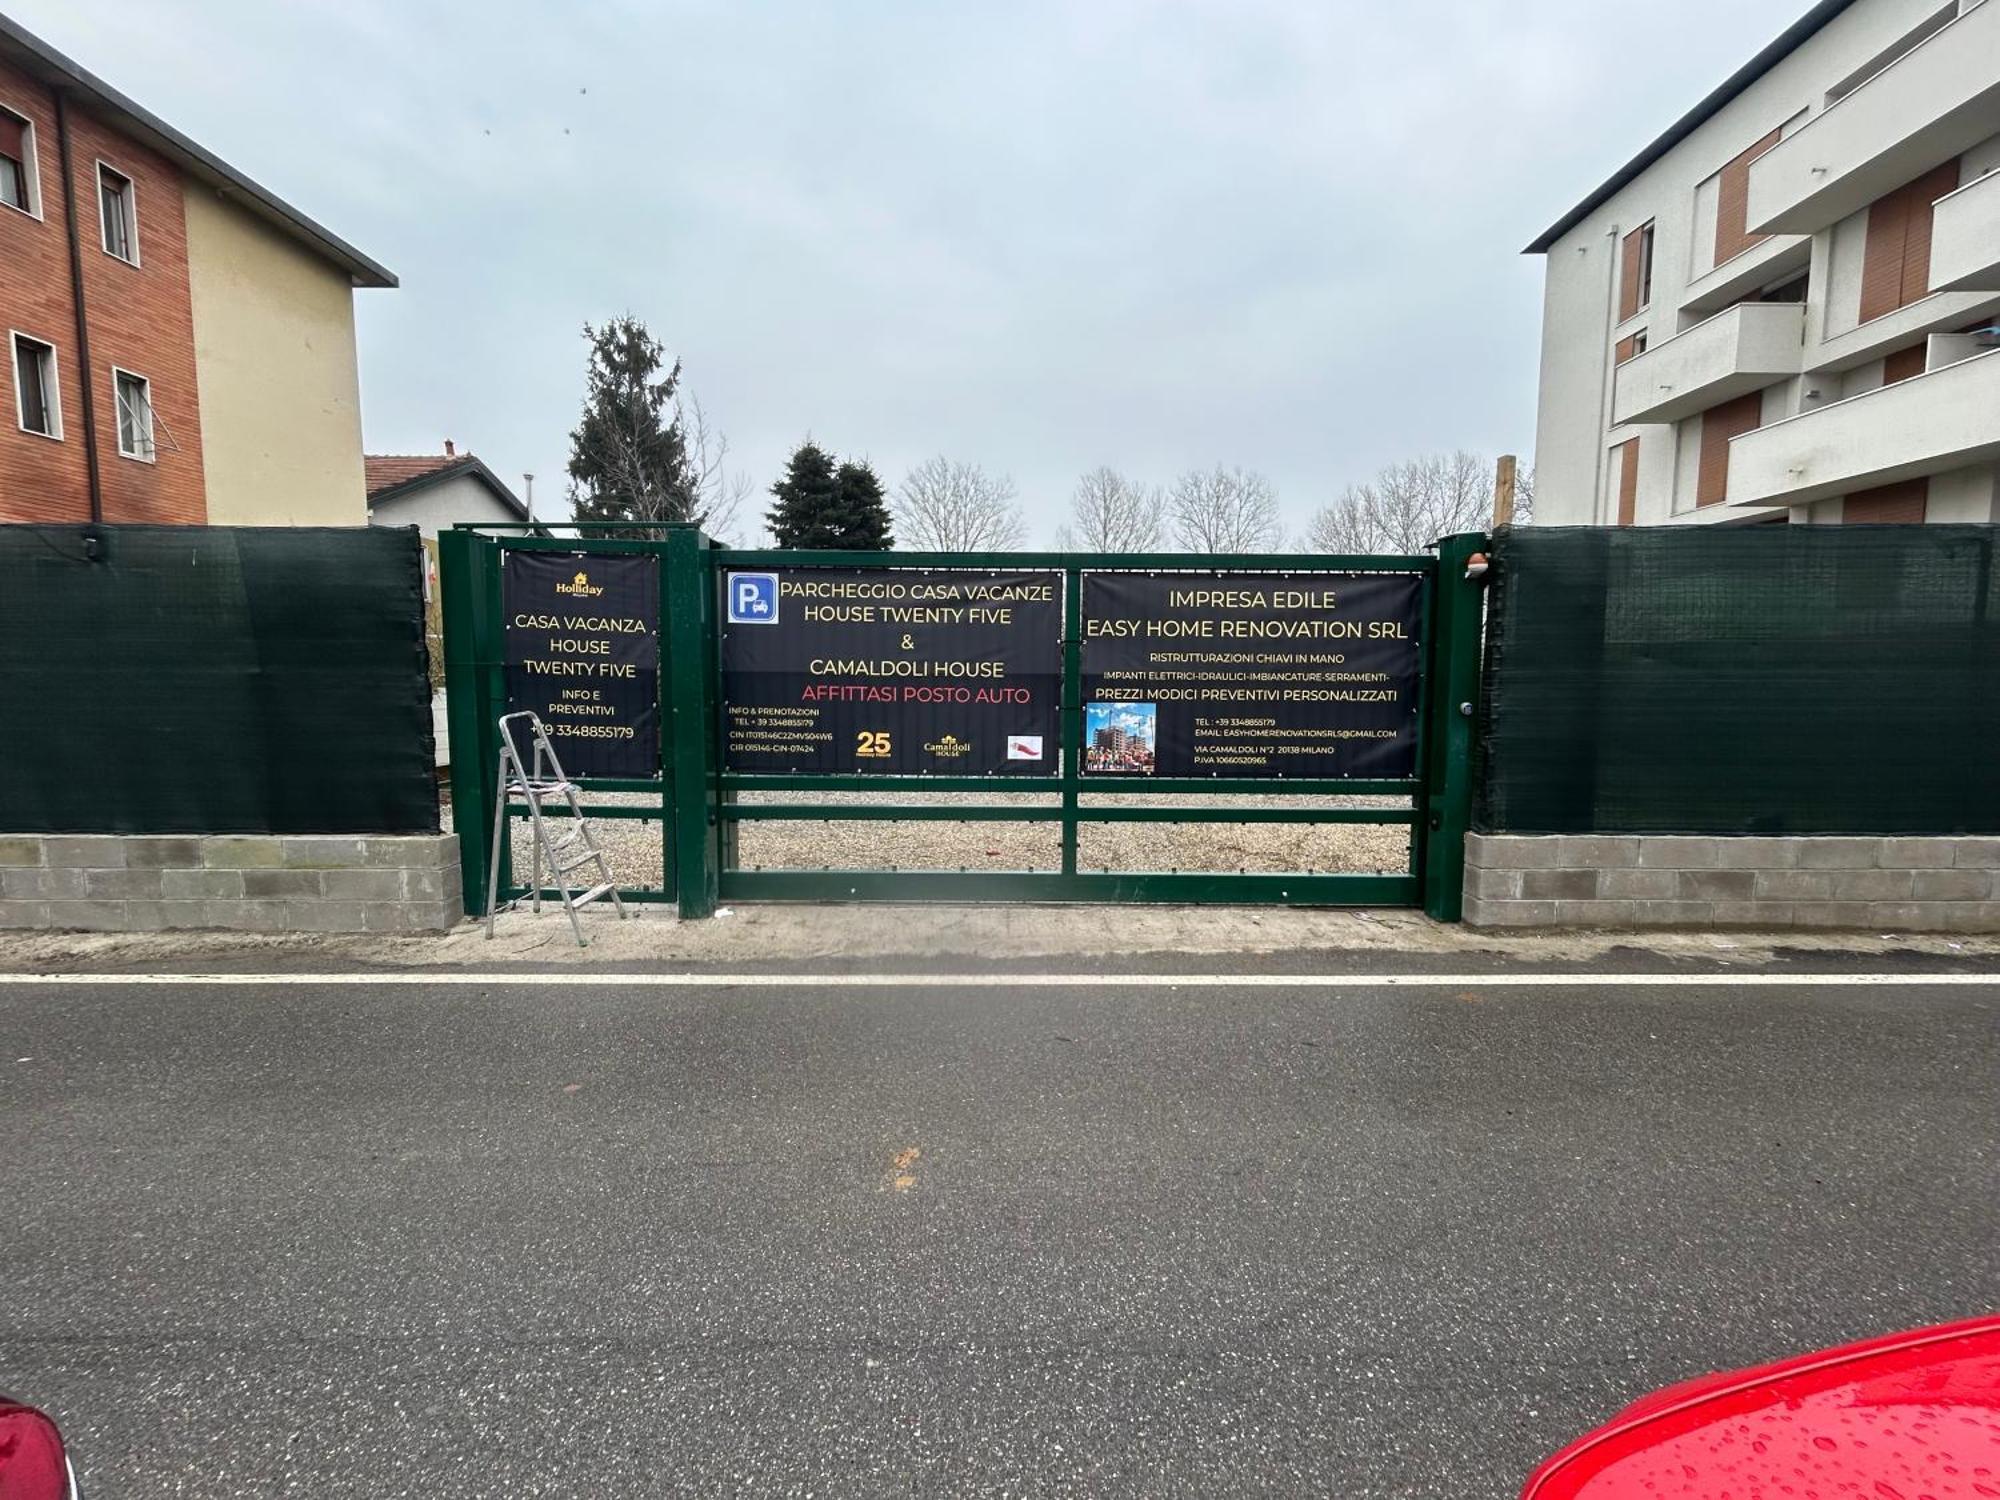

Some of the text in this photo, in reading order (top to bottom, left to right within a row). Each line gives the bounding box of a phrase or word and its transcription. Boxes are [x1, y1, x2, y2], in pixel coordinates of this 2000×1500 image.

[739, 583, 759, 613] P
[780, 582, 1052, 600] PARCHEGGIO CASA VACANZE
[1171, 591, 1335, 608] IMPRESA EDILE
[516, 615, 646, 632] CASA VACANZA
[805, 606, 1011, 624] HOUSE TWENTY FIVE
[1088, 620, 1407, 638] EASY HOME RENOVATION SRL
[551, 640, 609, 654] HOUSE
[902, 635, 913, 649] &
[1151, 653, 1253, 662] RISTRUTTURAZIONI
[1257, 654, 1292, 663] CHIAVI
[1311, 655, 1344, 663] MANO
[524, 660, 635, 677] TWENTY FIVE
[810, 660, 1003, 677] CAMALDOLI HOUSE
[563, 690, 600, 700] INFO E
[803, 685, 1029, 703] AFFITTASI POSTO AUTO
[1096, 688, 1396, 701] PREZZI MODICI PREVENTIVI PERSONALIZZATI
[549, 704, 614, 715] PREVENTIVI
[530, 723, 633, 738] +9 3348855179
[857, 732, 891, 753] 25
[923, 742, 970, 751] Camaldoli
